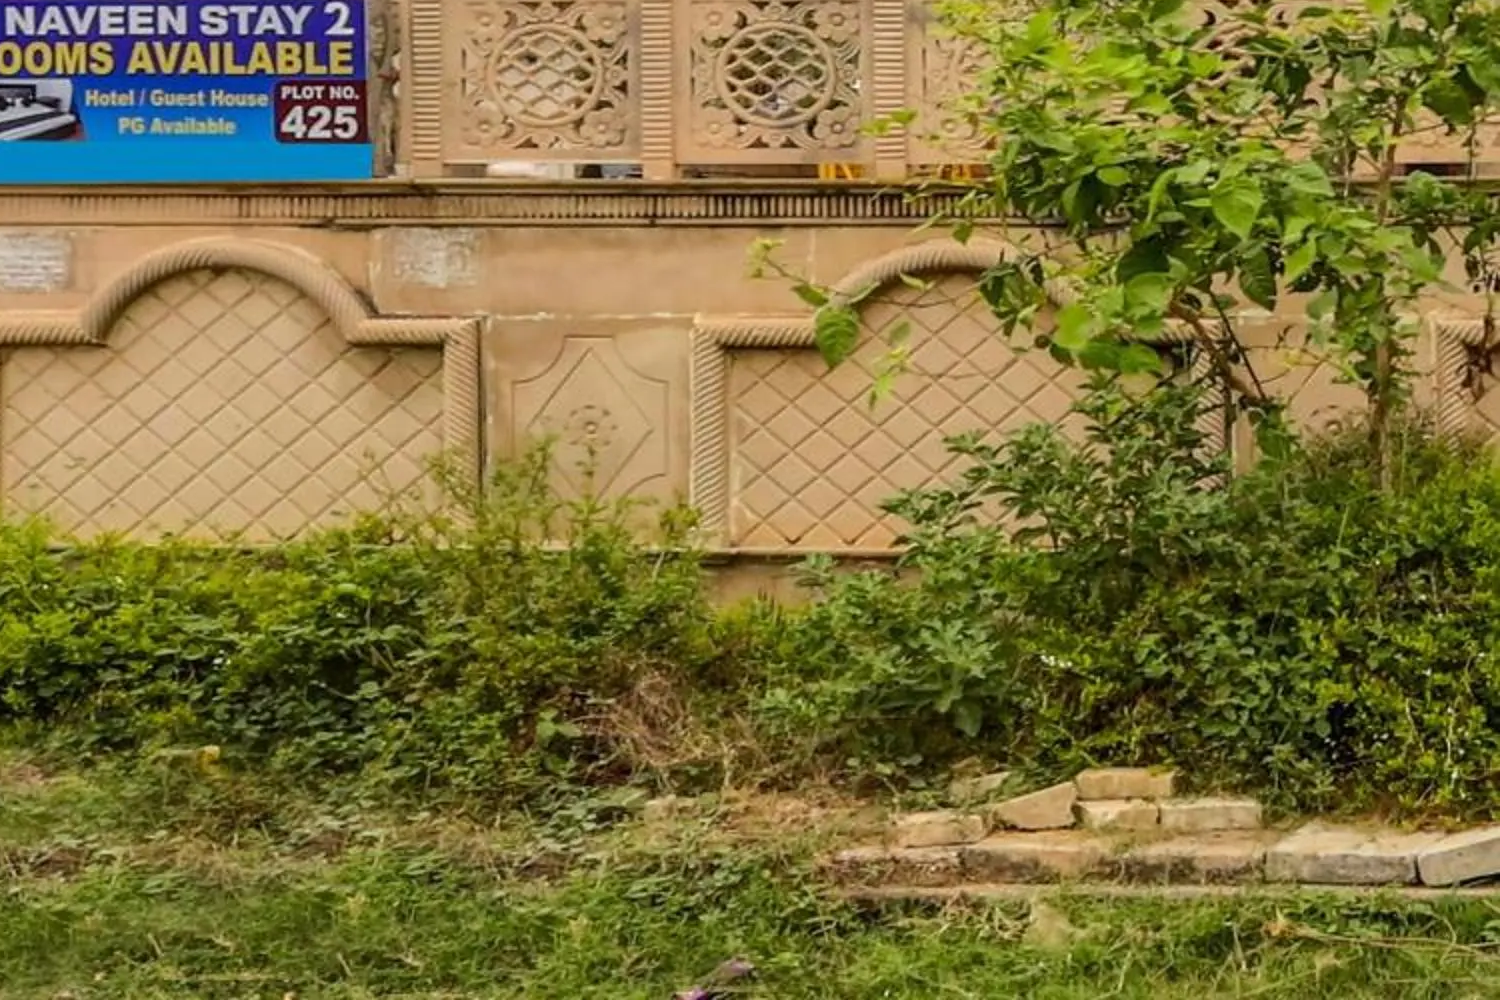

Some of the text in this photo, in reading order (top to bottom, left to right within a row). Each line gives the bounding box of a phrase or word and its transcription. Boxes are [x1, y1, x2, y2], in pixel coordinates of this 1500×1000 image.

[5, 2, 355, 36] NAVEEN STAY 2
[127, 41, 353, 75] AVAILABLE
[85, 89, 269, 108] Hotel / Guest House
[281, 85, 360, 100] PLOT NO.
[118, 117, 237, 135] PG Available
[280, 105, 359, 139] 425
